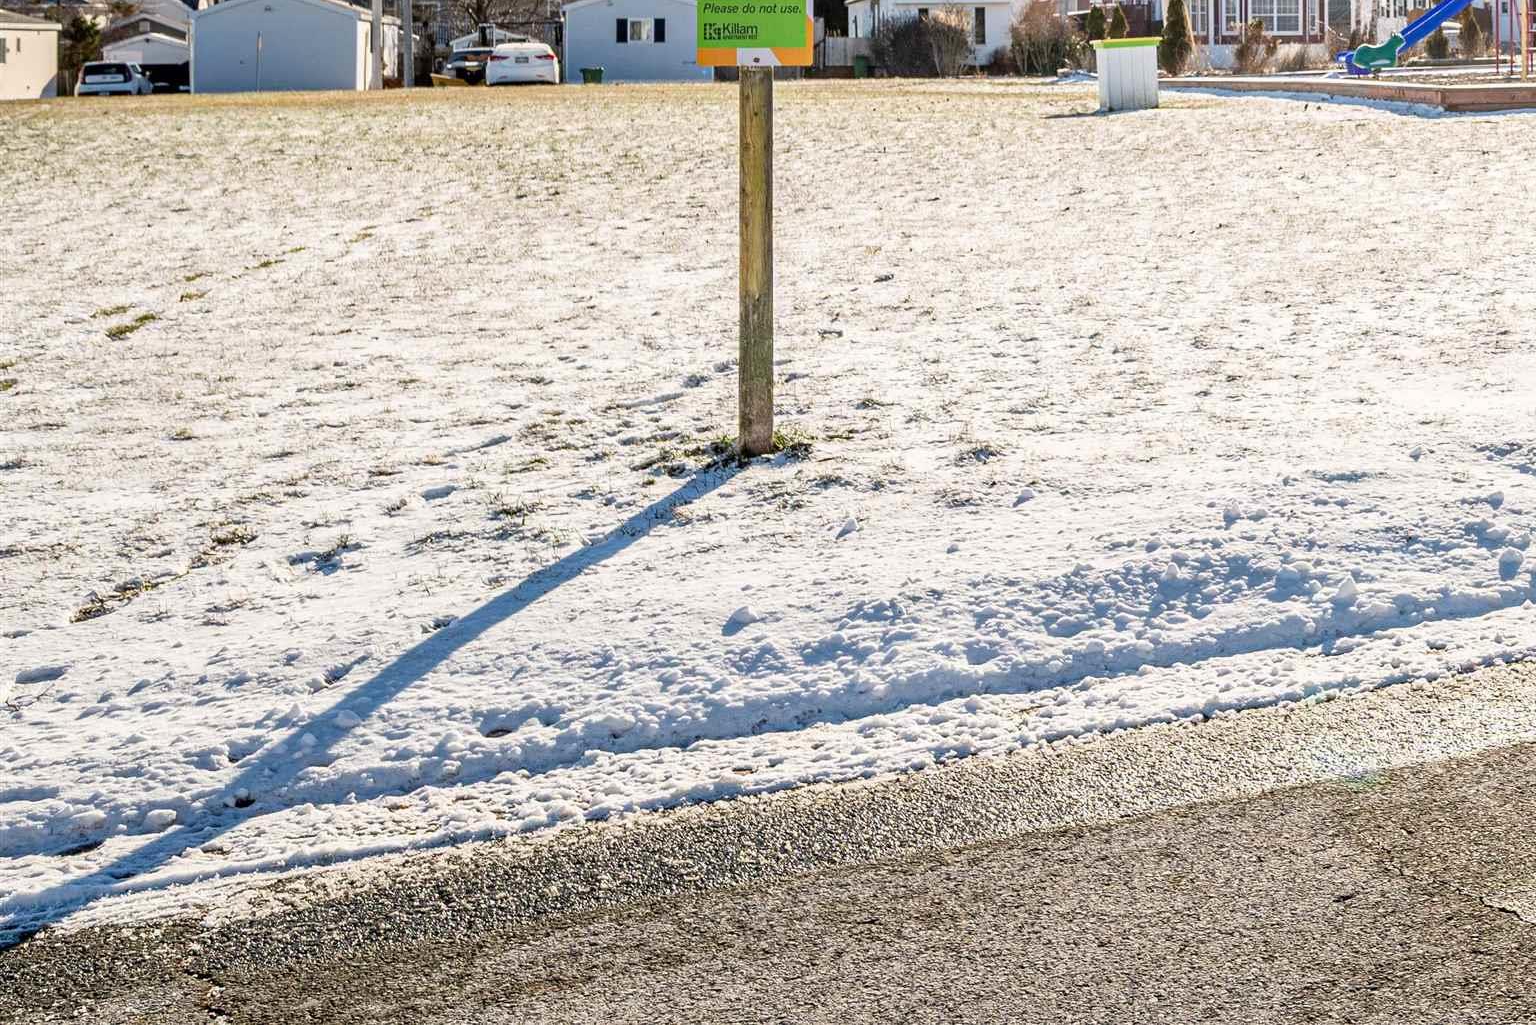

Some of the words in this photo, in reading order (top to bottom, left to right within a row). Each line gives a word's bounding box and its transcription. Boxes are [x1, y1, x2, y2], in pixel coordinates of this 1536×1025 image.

[703, 3, 738, 14] Please
[742, 4, 756, 14] do
[759, 4, 777, 14] not
[780, 5, 801, 14] use.
[722, 23, 758, 35] Killam
